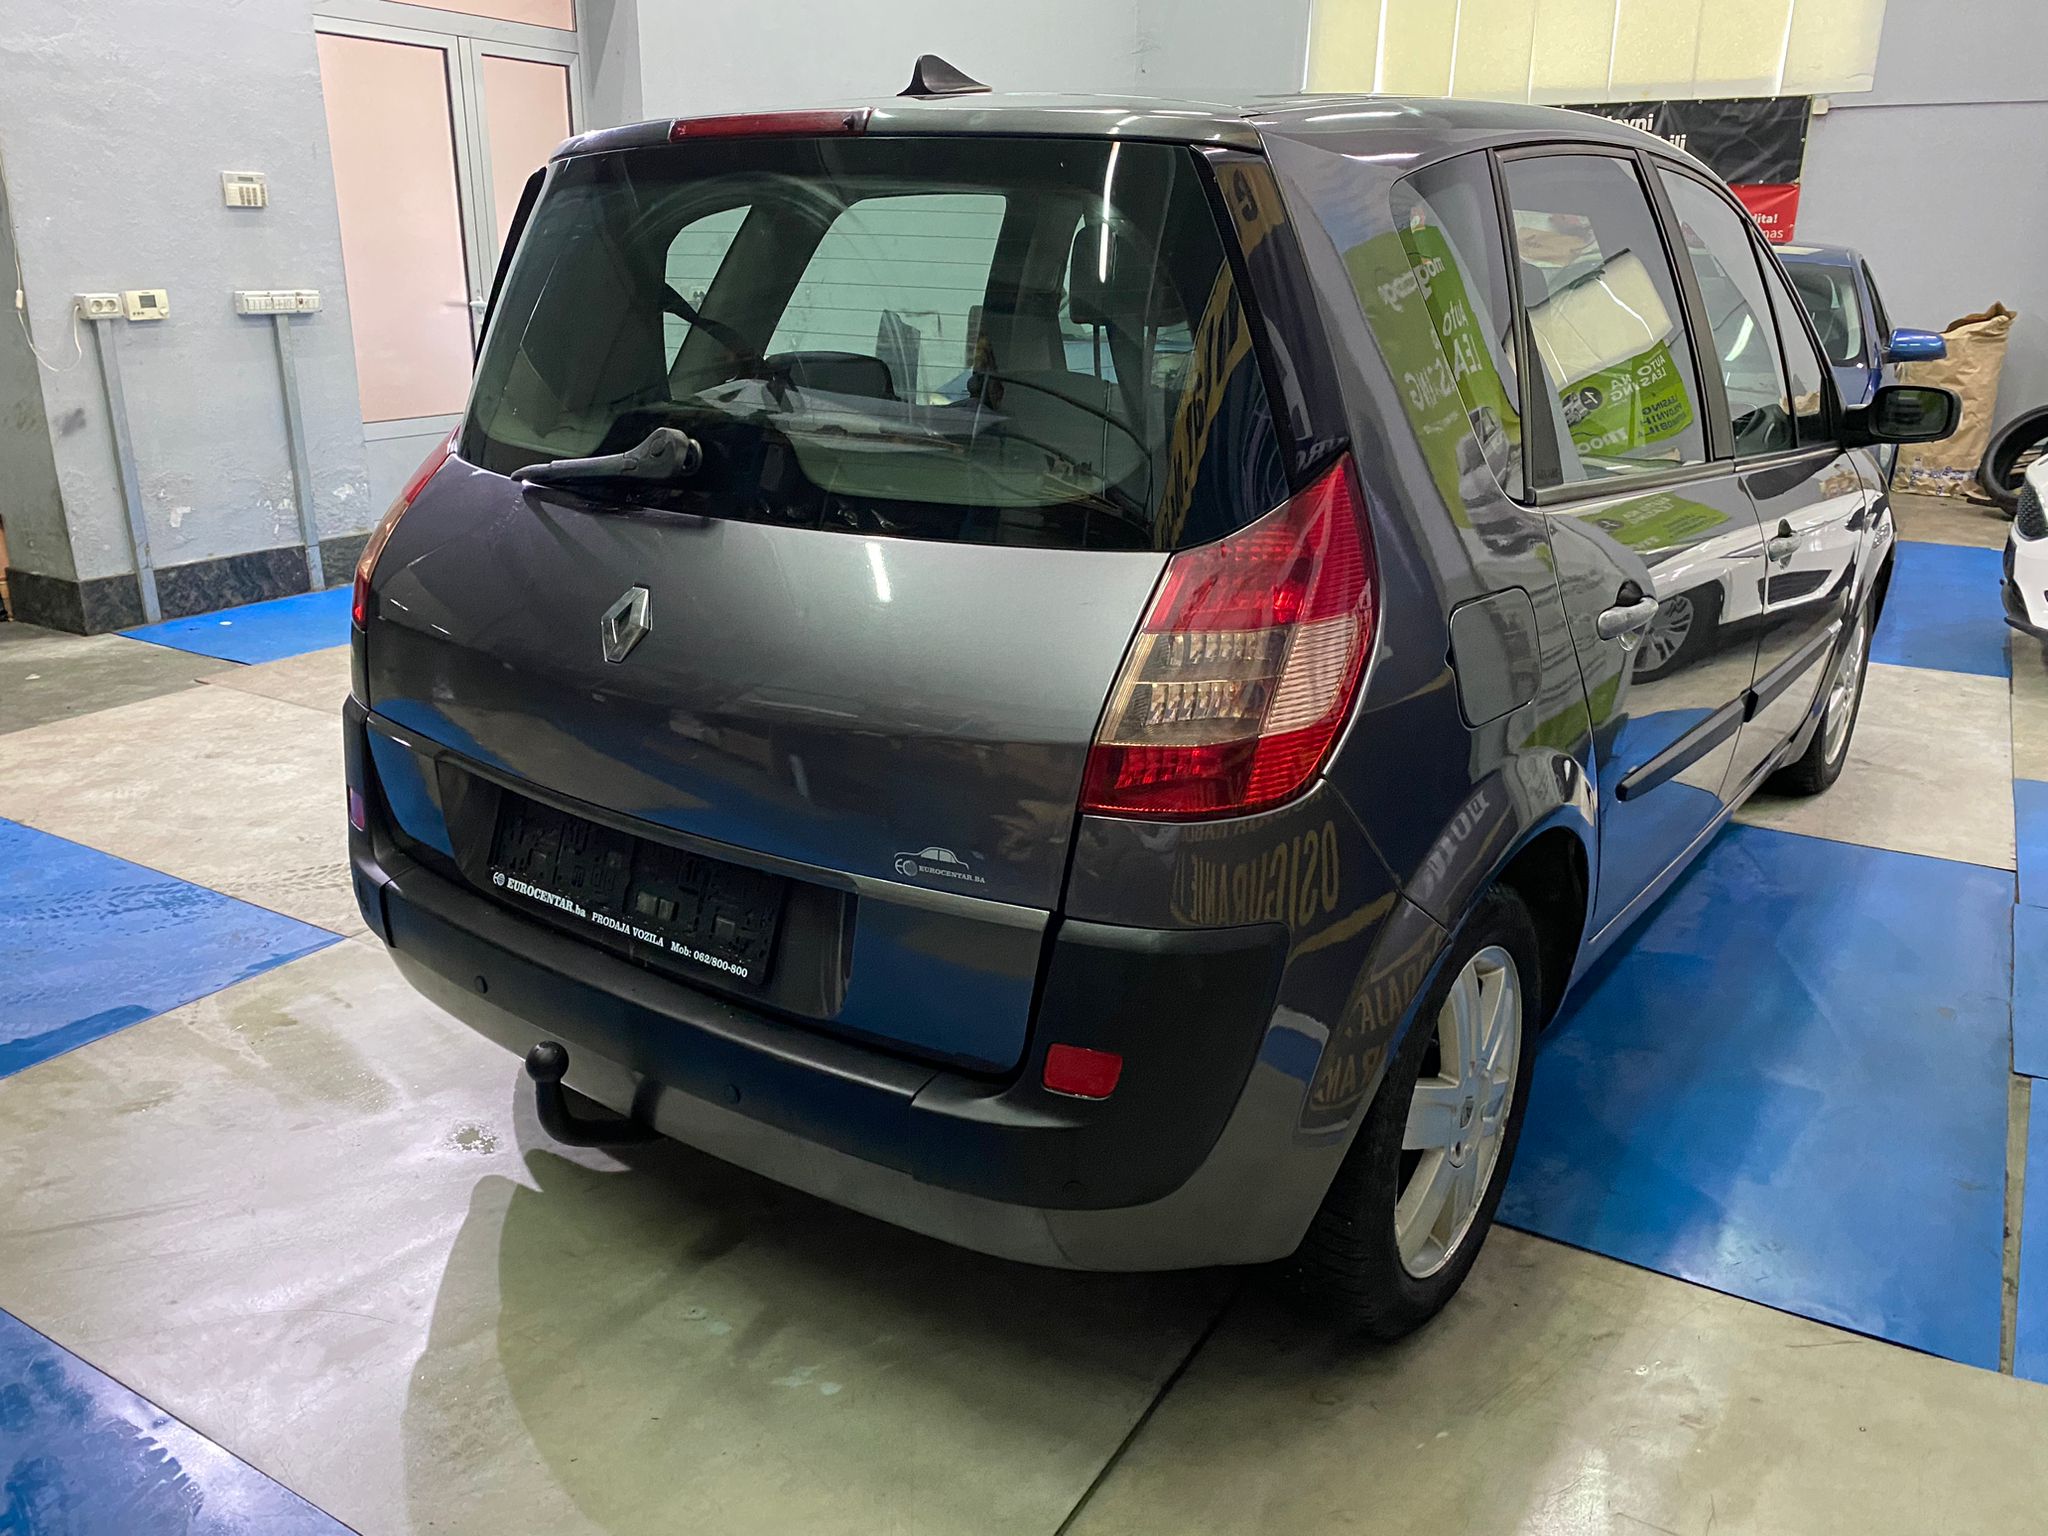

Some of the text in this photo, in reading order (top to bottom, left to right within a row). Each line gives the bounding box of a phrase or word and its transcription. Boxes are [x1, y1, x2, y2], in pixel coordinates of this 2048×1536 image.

[506, 877, 748, 978] EUROCENTAR.ba PRODAJA VOZILA Mob: 062/800-800
